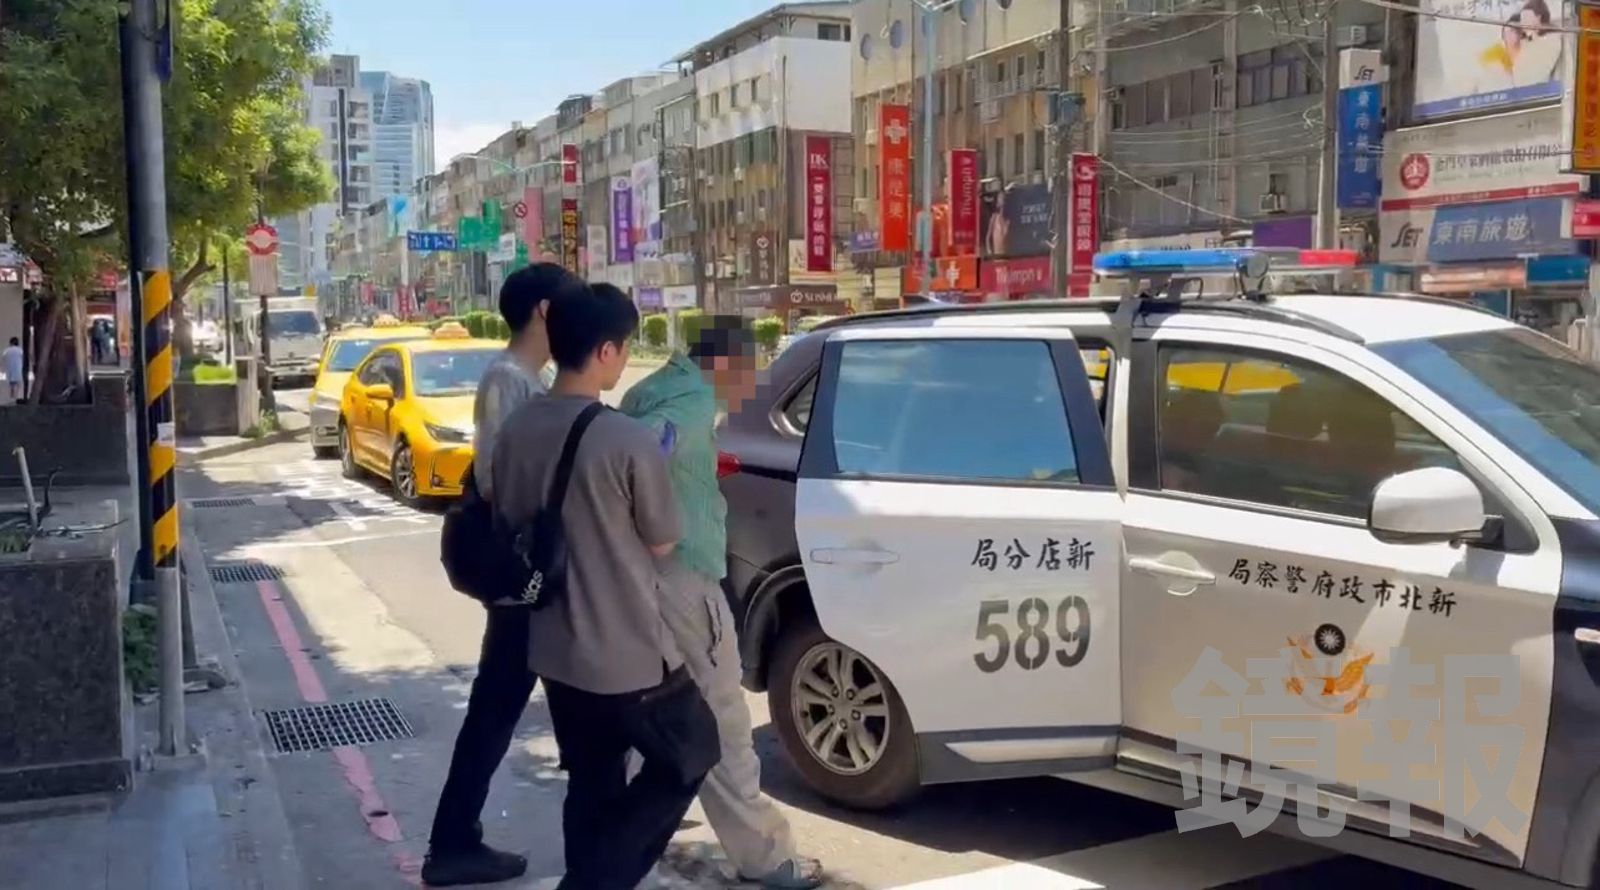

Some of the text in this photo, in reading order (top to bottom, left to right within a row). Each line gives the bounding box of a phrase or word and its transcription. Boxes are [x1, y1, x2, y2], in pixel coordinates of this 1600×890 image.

[810, 153, 828, 167] DK
[960, 166, 975, 217] Triumph
[1433, 214, 1529, 245] 東南旅遊
[974, 595, 1091, 673] 589
